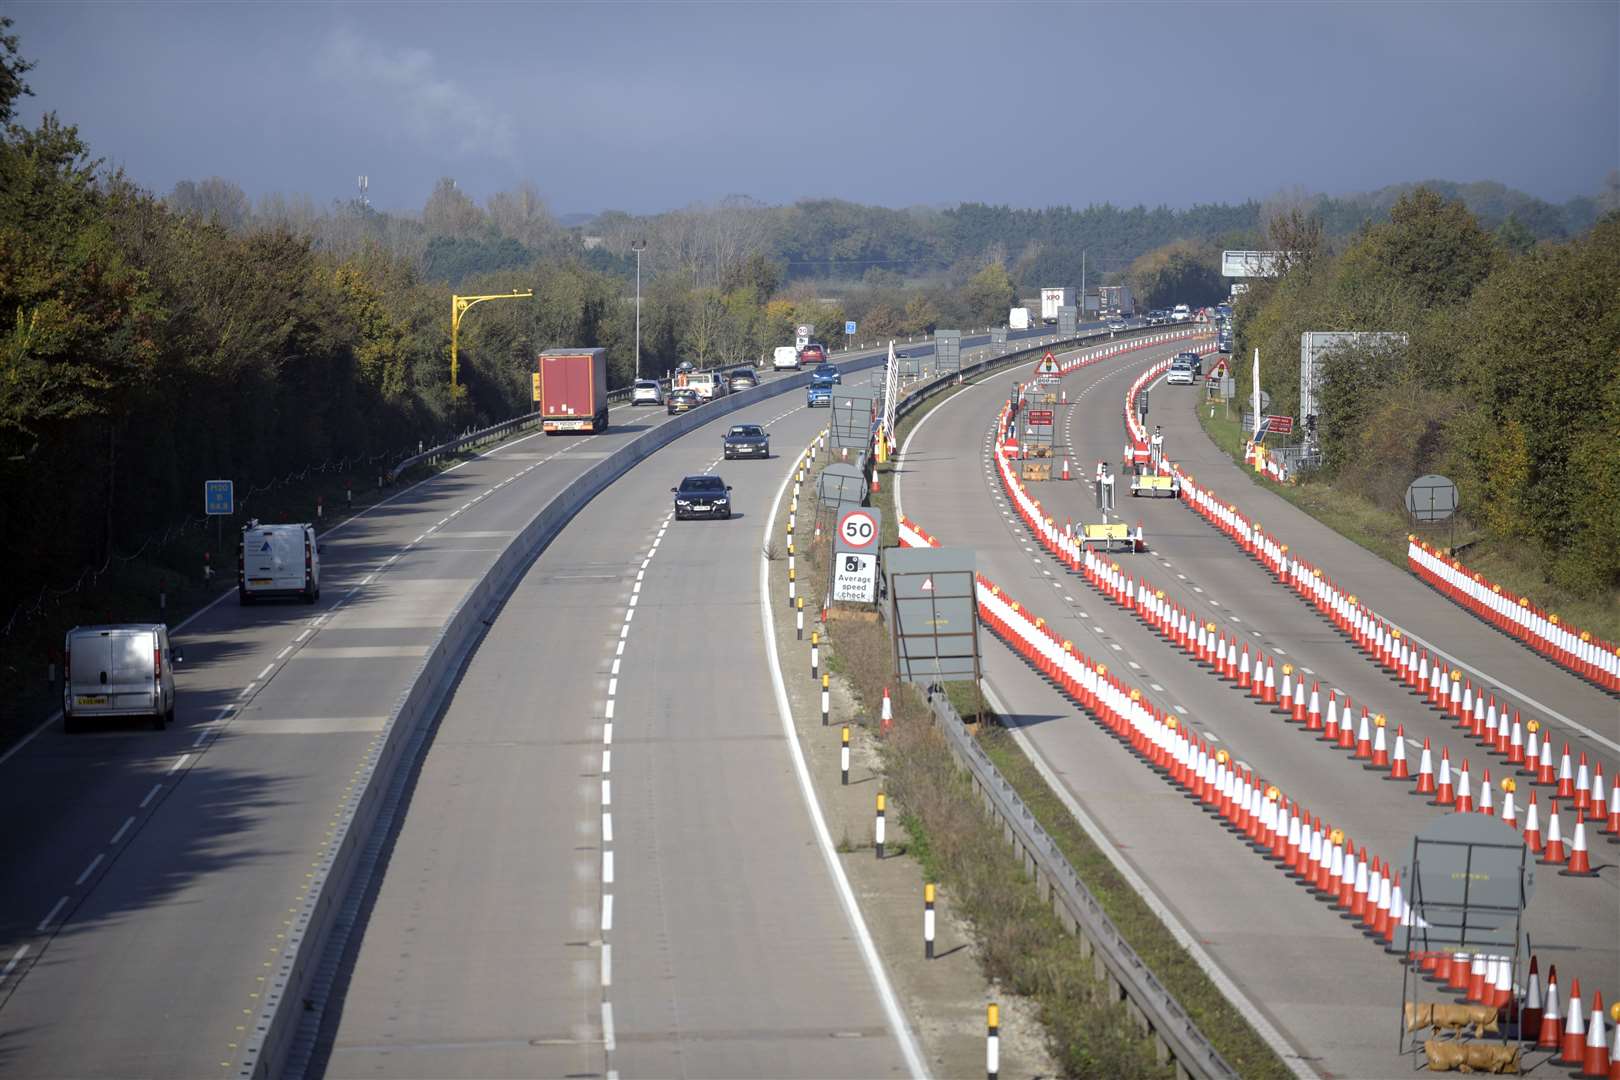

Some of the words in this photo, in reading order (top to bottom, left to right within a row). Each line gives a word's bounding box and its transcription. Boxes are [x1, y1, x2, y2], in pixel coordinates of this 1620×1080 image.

[846, 522, 872, 538] 50
[838, 573, 872, 584] Average
[842, 583, 867, 592] speed
[841, 591, 866, 600] check
